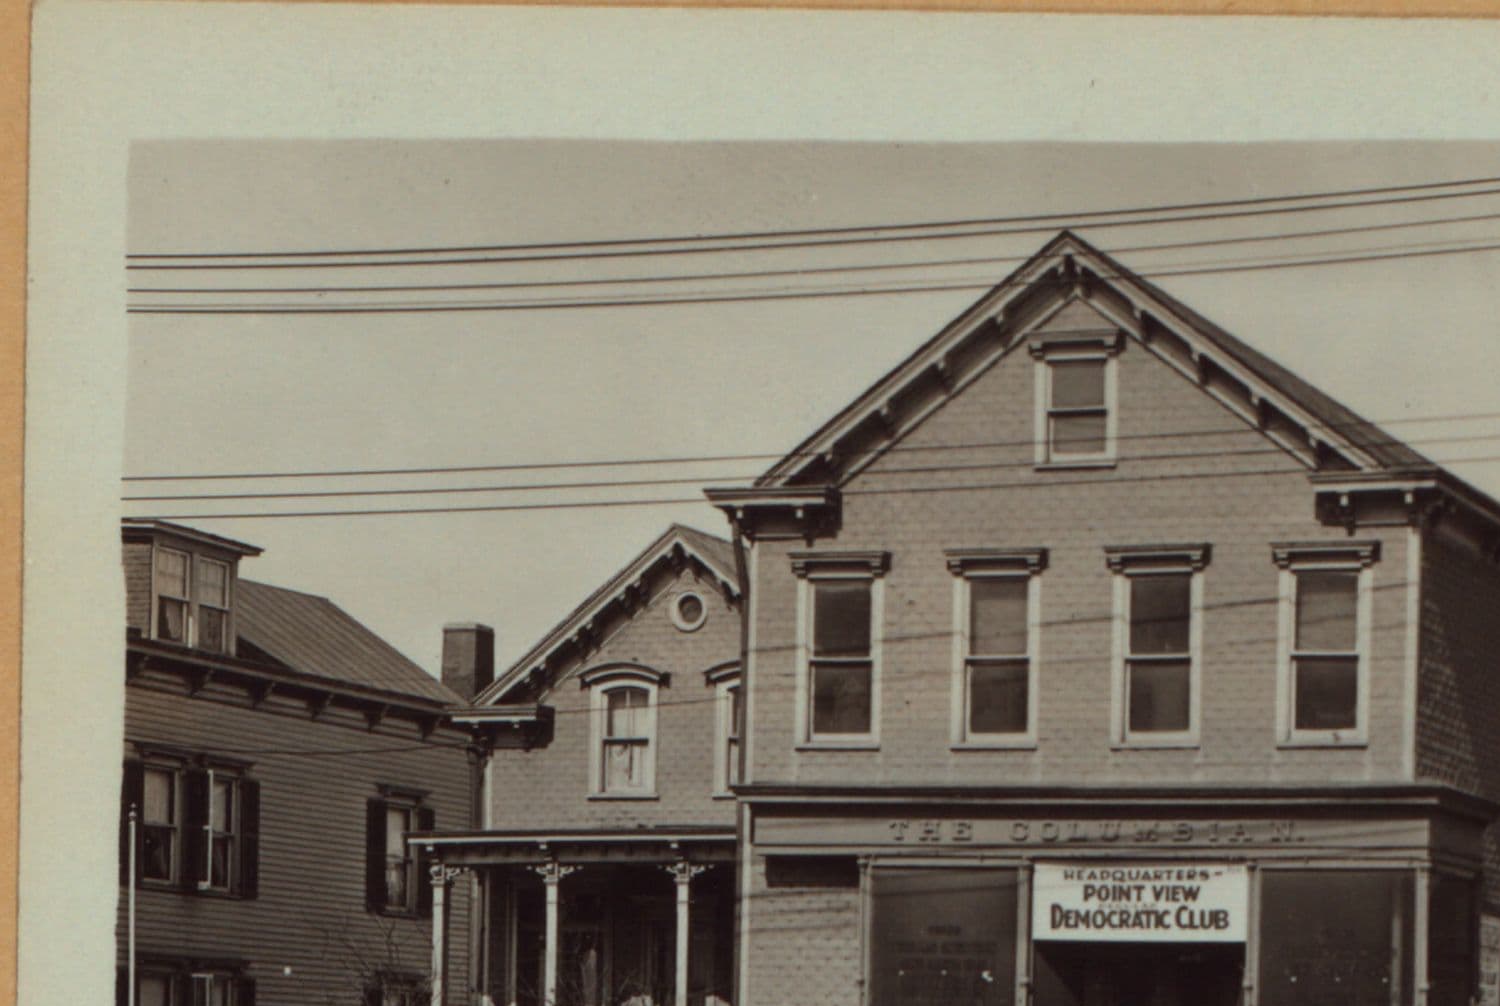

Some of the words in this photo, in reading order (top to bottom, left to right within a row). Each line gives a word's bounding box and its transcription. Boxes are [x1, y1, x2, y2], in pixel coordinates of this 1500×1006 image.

[889, 821, 973, 842] THE
[1083, 884, 1145, 902] POINT
[1152, 884, 1201, 902] VIEW
[1050, 903, 1171, 930] DEMOCRATIC
[1175, 905, 1229, 930] CLUB
